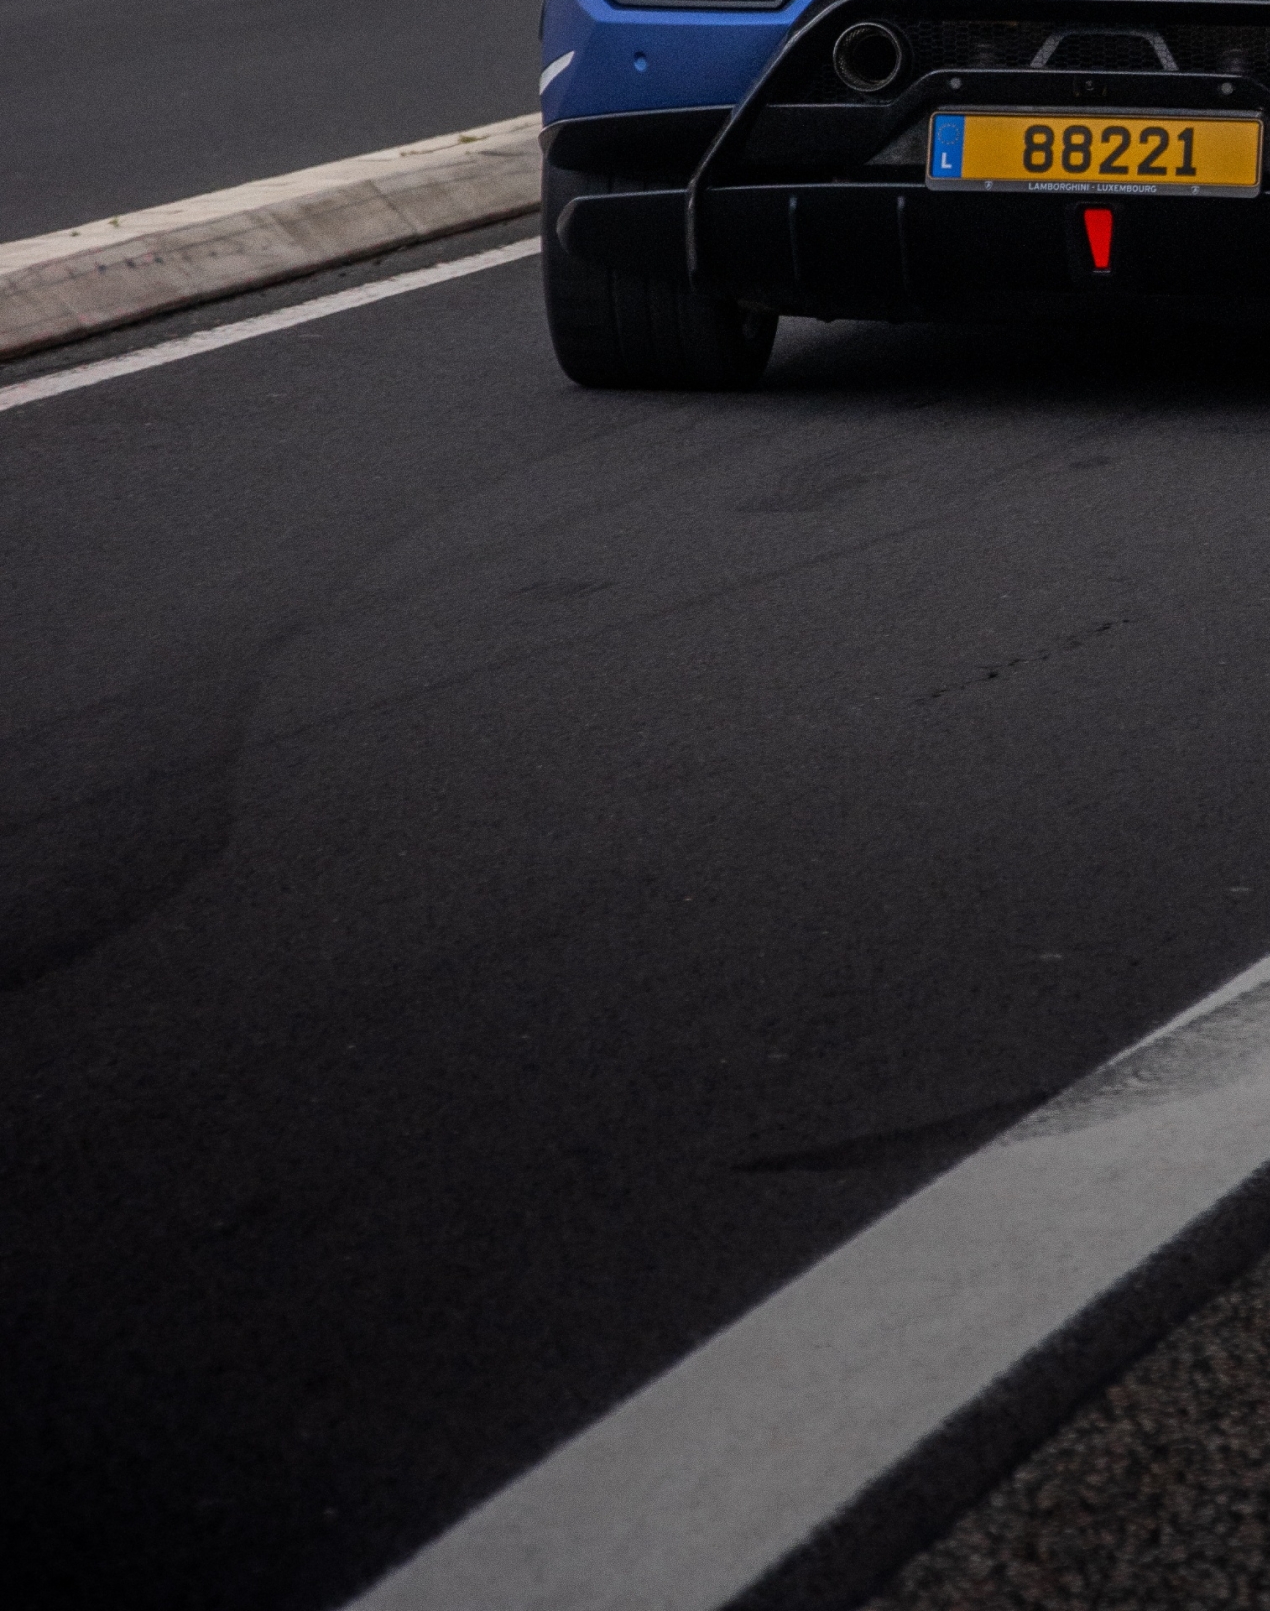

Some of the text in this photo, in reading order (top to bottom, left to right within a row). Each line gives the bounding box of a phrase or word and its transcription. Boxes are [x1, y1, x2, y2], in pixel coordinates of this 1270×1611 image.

[1023, 124, 1197, 177] 88221
[941, 152, 952, 169] L
[1028, 182, 1090, 191] LAMBORGHINI
[1096, 184, 1157, 193] LUXEMBOURG
